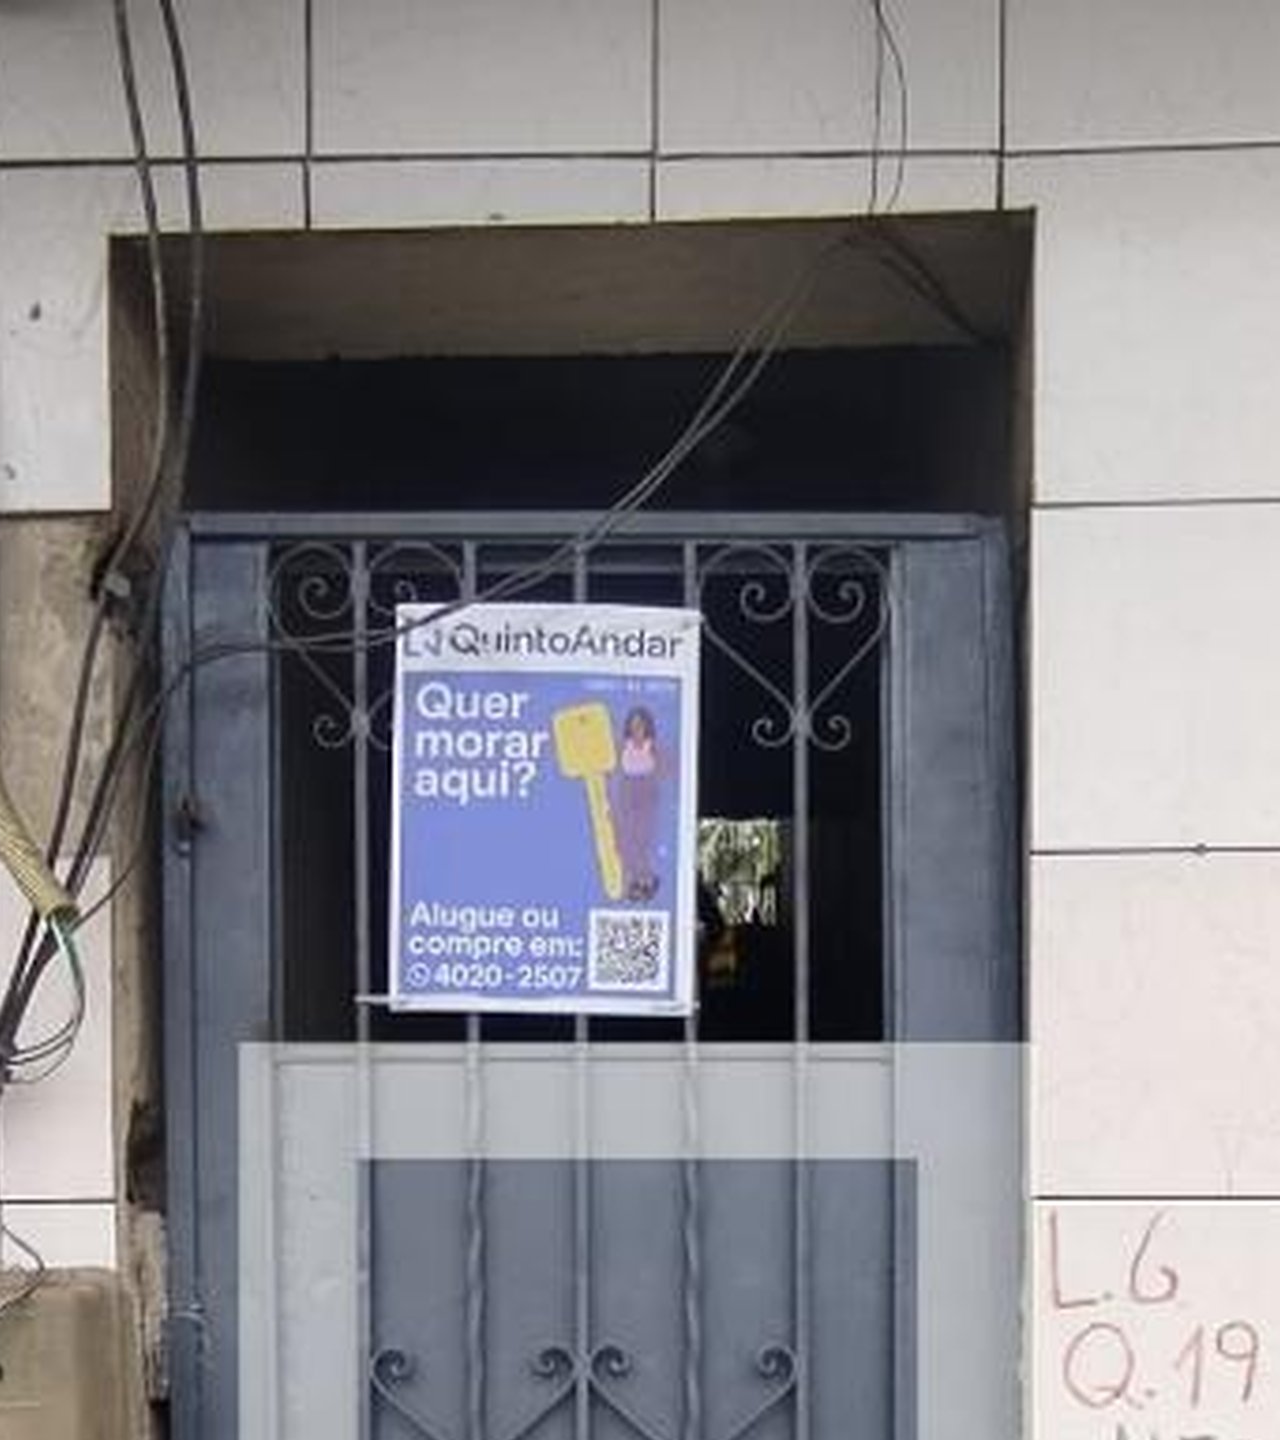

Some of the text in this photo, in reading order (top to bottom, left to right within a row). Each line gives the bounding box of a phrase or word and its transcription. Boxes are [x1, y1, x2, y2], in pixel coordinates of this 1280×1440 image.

[449, 622, 682, 659] QuintoAndar
[418, 681, 529, 720] Quer
[414, 725, 549, 759] morar
[413, 760, 538, 804] aqui?
[410, 901, 560, 934] Alugue ou
[409, 935, 523, 960] compre
